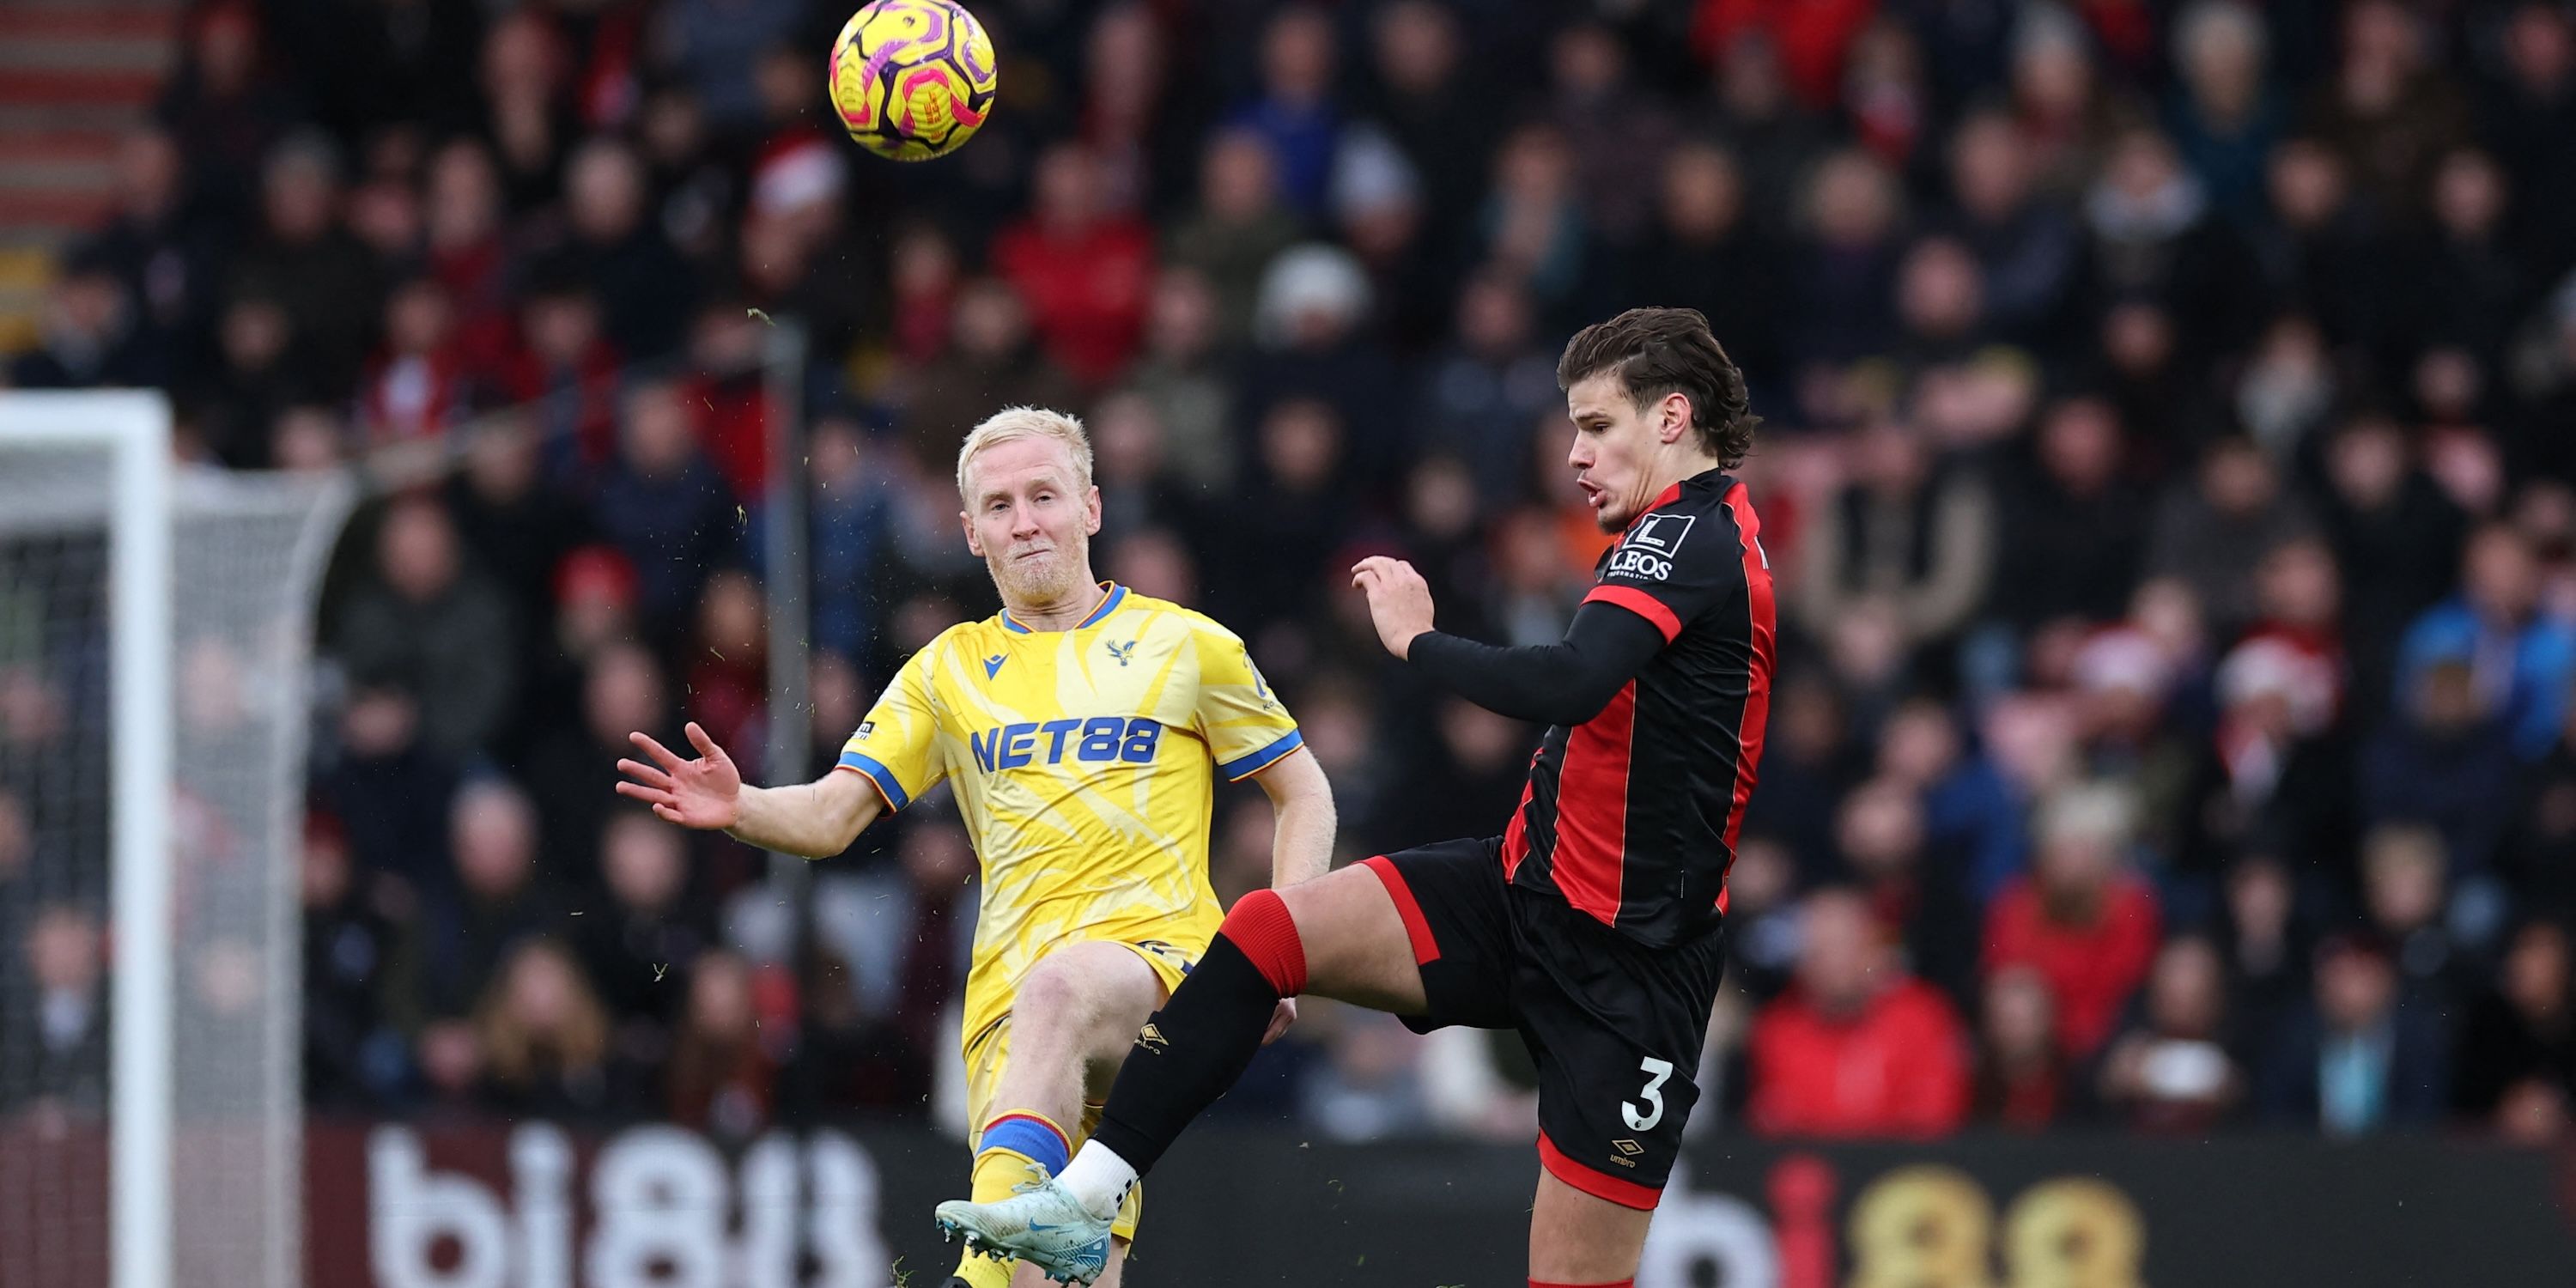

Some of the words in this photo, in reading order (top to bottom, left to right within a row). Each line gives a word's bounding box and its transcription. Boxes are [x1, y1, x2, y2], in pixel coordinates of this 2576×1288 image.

[1610, 550, 1673, 581] LEOS
[970, 716, 1162, 775] NET88
[1621, 1056, 1674, 1132] 3
[1609, 1153, 1636, 1169] umbro
